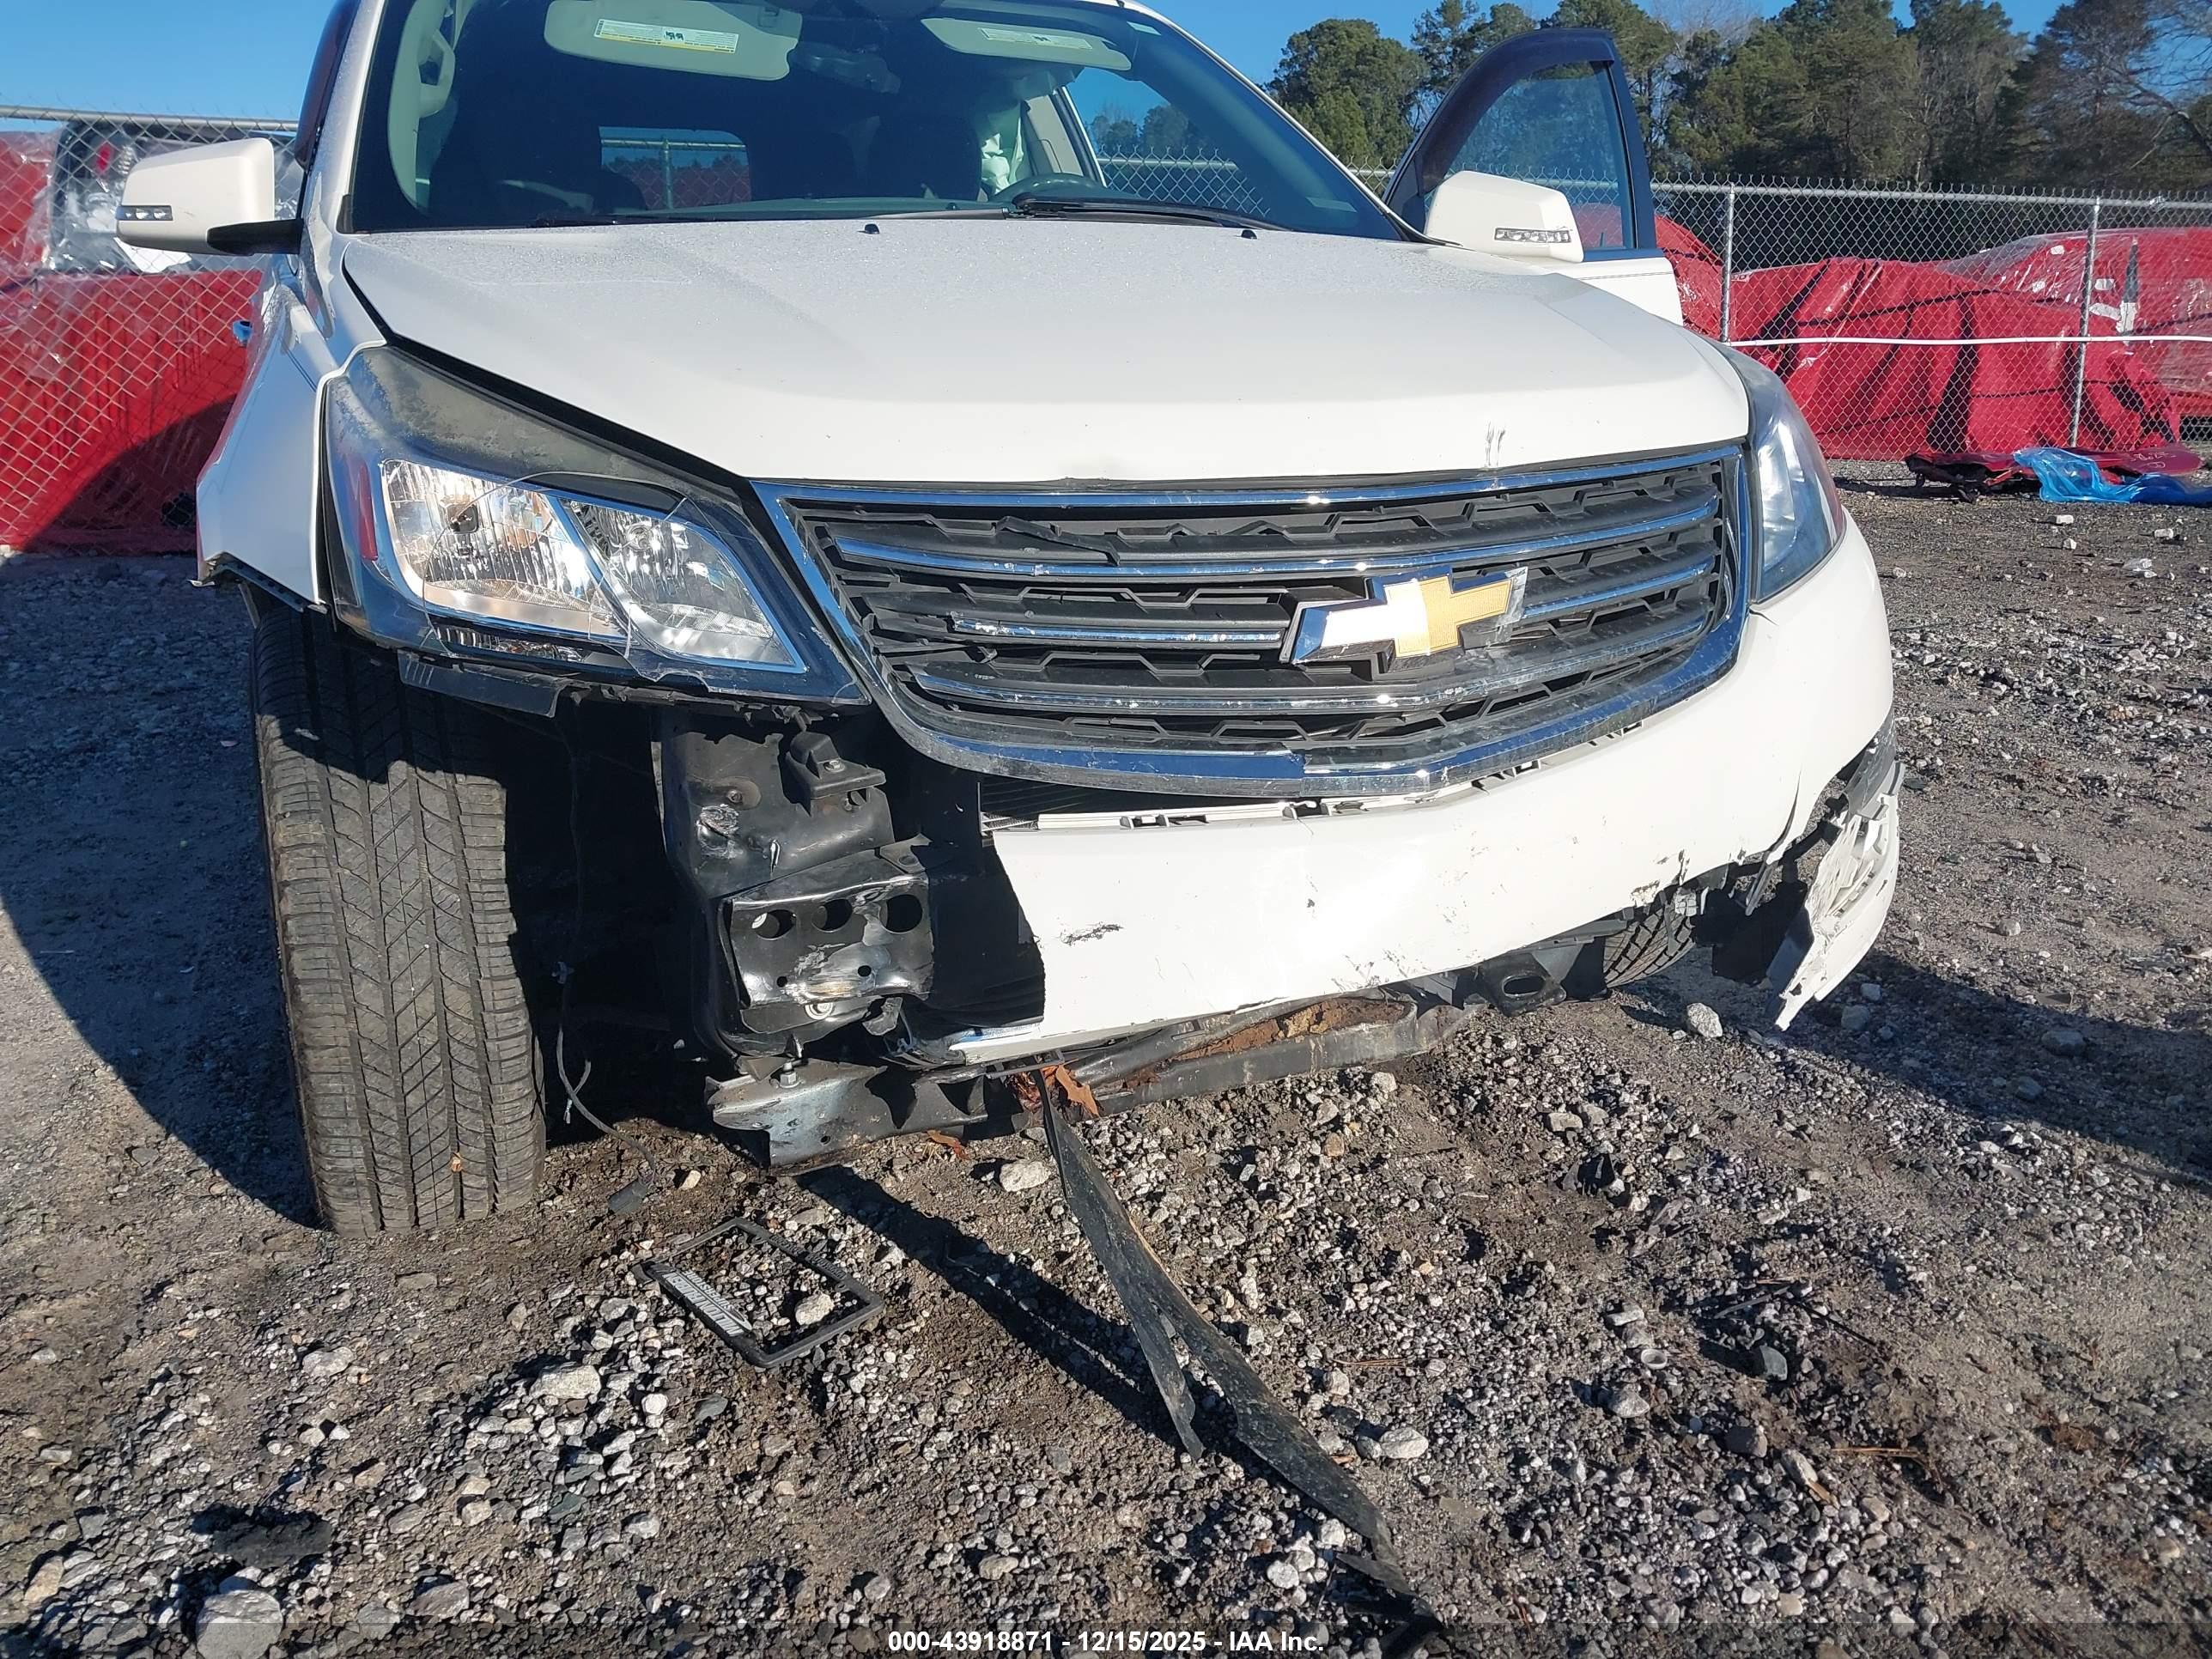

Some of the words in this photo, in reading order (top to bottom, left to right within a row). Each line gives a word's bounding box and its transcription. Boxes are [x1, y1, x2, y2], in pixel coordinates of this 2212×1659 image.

[662, 1272, 706, 1304] RUBEN
[682, 1270, 732, 1310] SUPERSTORE
[694, 1300, 744, 1336] MILTON
